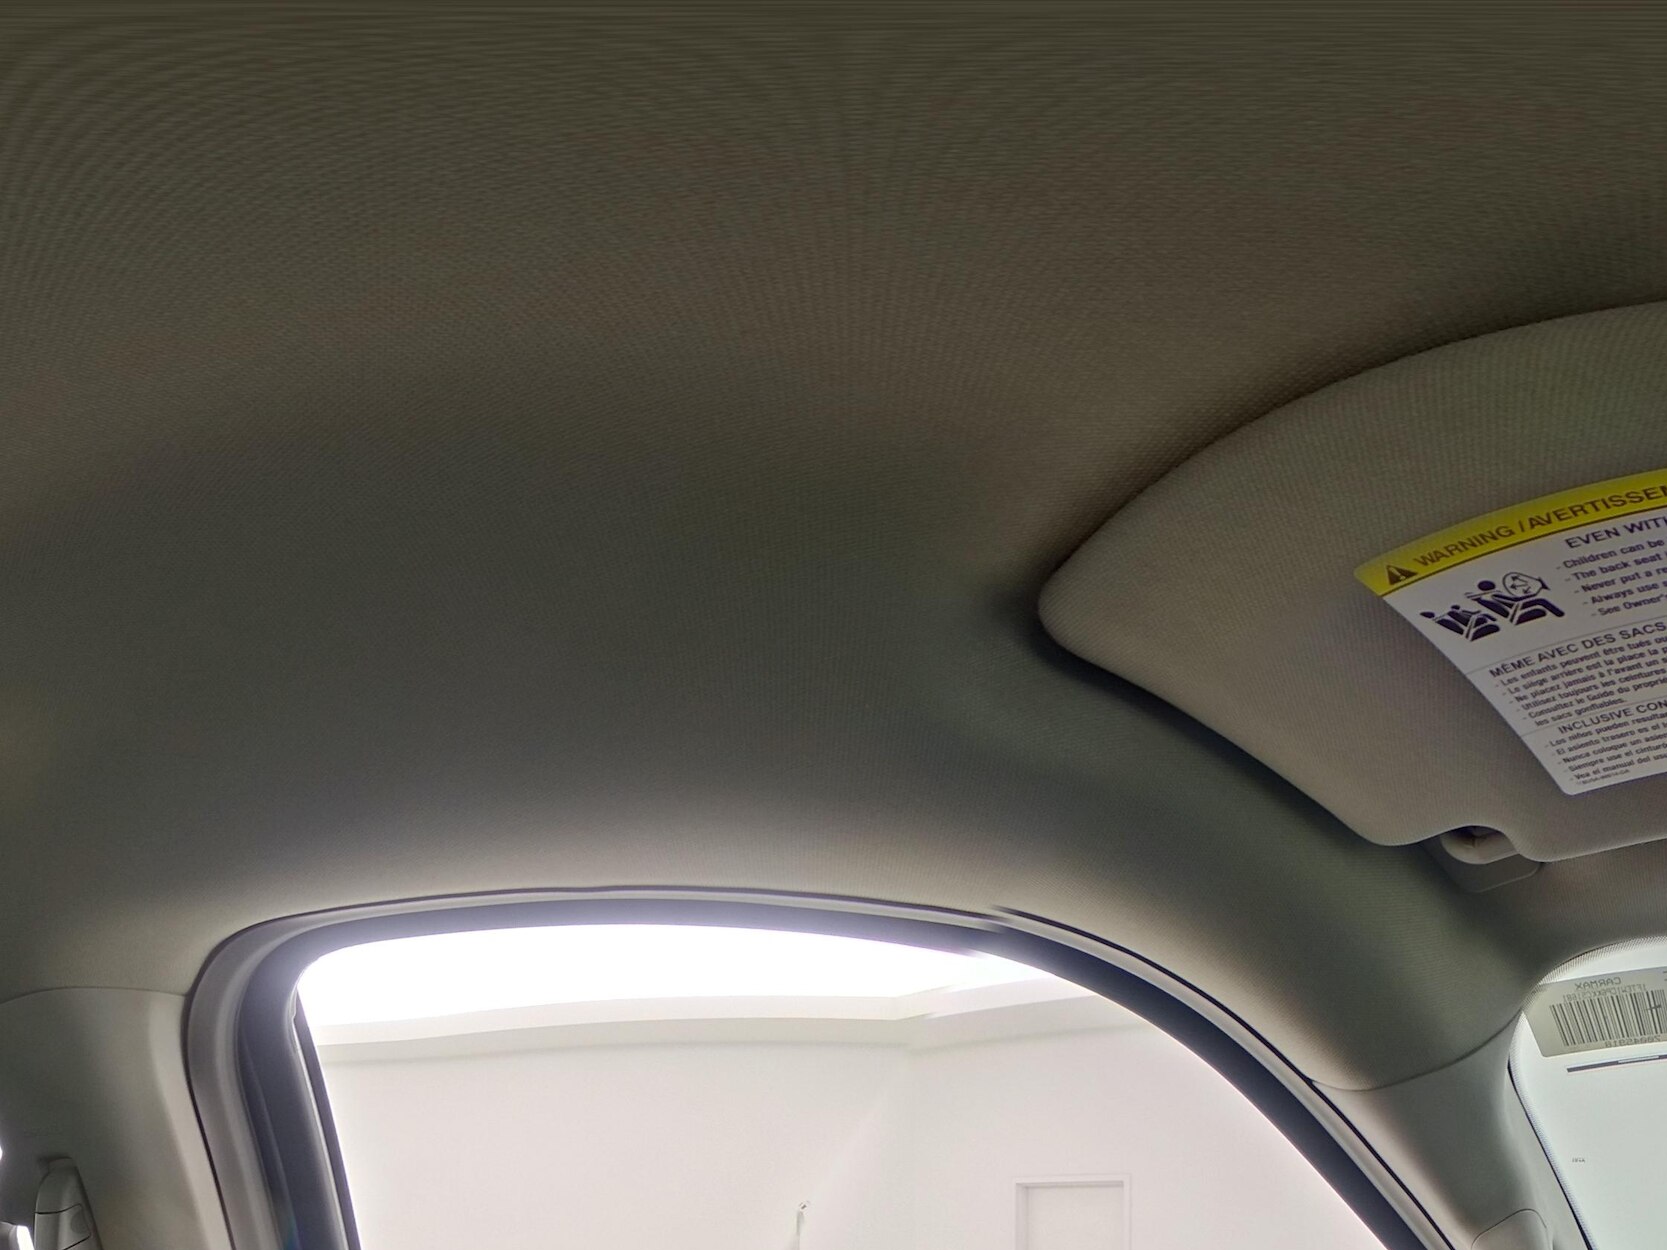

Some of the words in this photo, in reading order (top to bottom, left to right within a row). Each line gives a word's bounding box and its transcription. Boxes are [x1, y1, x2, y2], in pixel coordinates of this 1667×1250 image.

[1412, 525, 1516, 567] WARNING
[1564, 526, 1622, 549] EVEN
[1562, 550, 1618, 569] Children
[1619, 543, 1646, 555] can
[1646, 539, 1666, 549] be
[1570, 569, 1598, 581] The
[1597, 561, 1632, 575] back
[1632, 553, 1664, 566] seat
[1580, 578, 1617, 593] Never
[1619, 571, 1643, 585] put
[1643, 570, 1654, 578] a
[1590, 588, 1635, 605] Always
[1635, 582, 1660, 594] use
[1597, 605, 1622, 617] See
[1488, 655, 1536, 678] MÊME
[1537, 643, 1580, 663] AVEC
[1580, 633, 1617, 650] DES
[1618, 621, 1667, 640] SACS
[1557, 707, 1635, 735] INCLUSIVE
